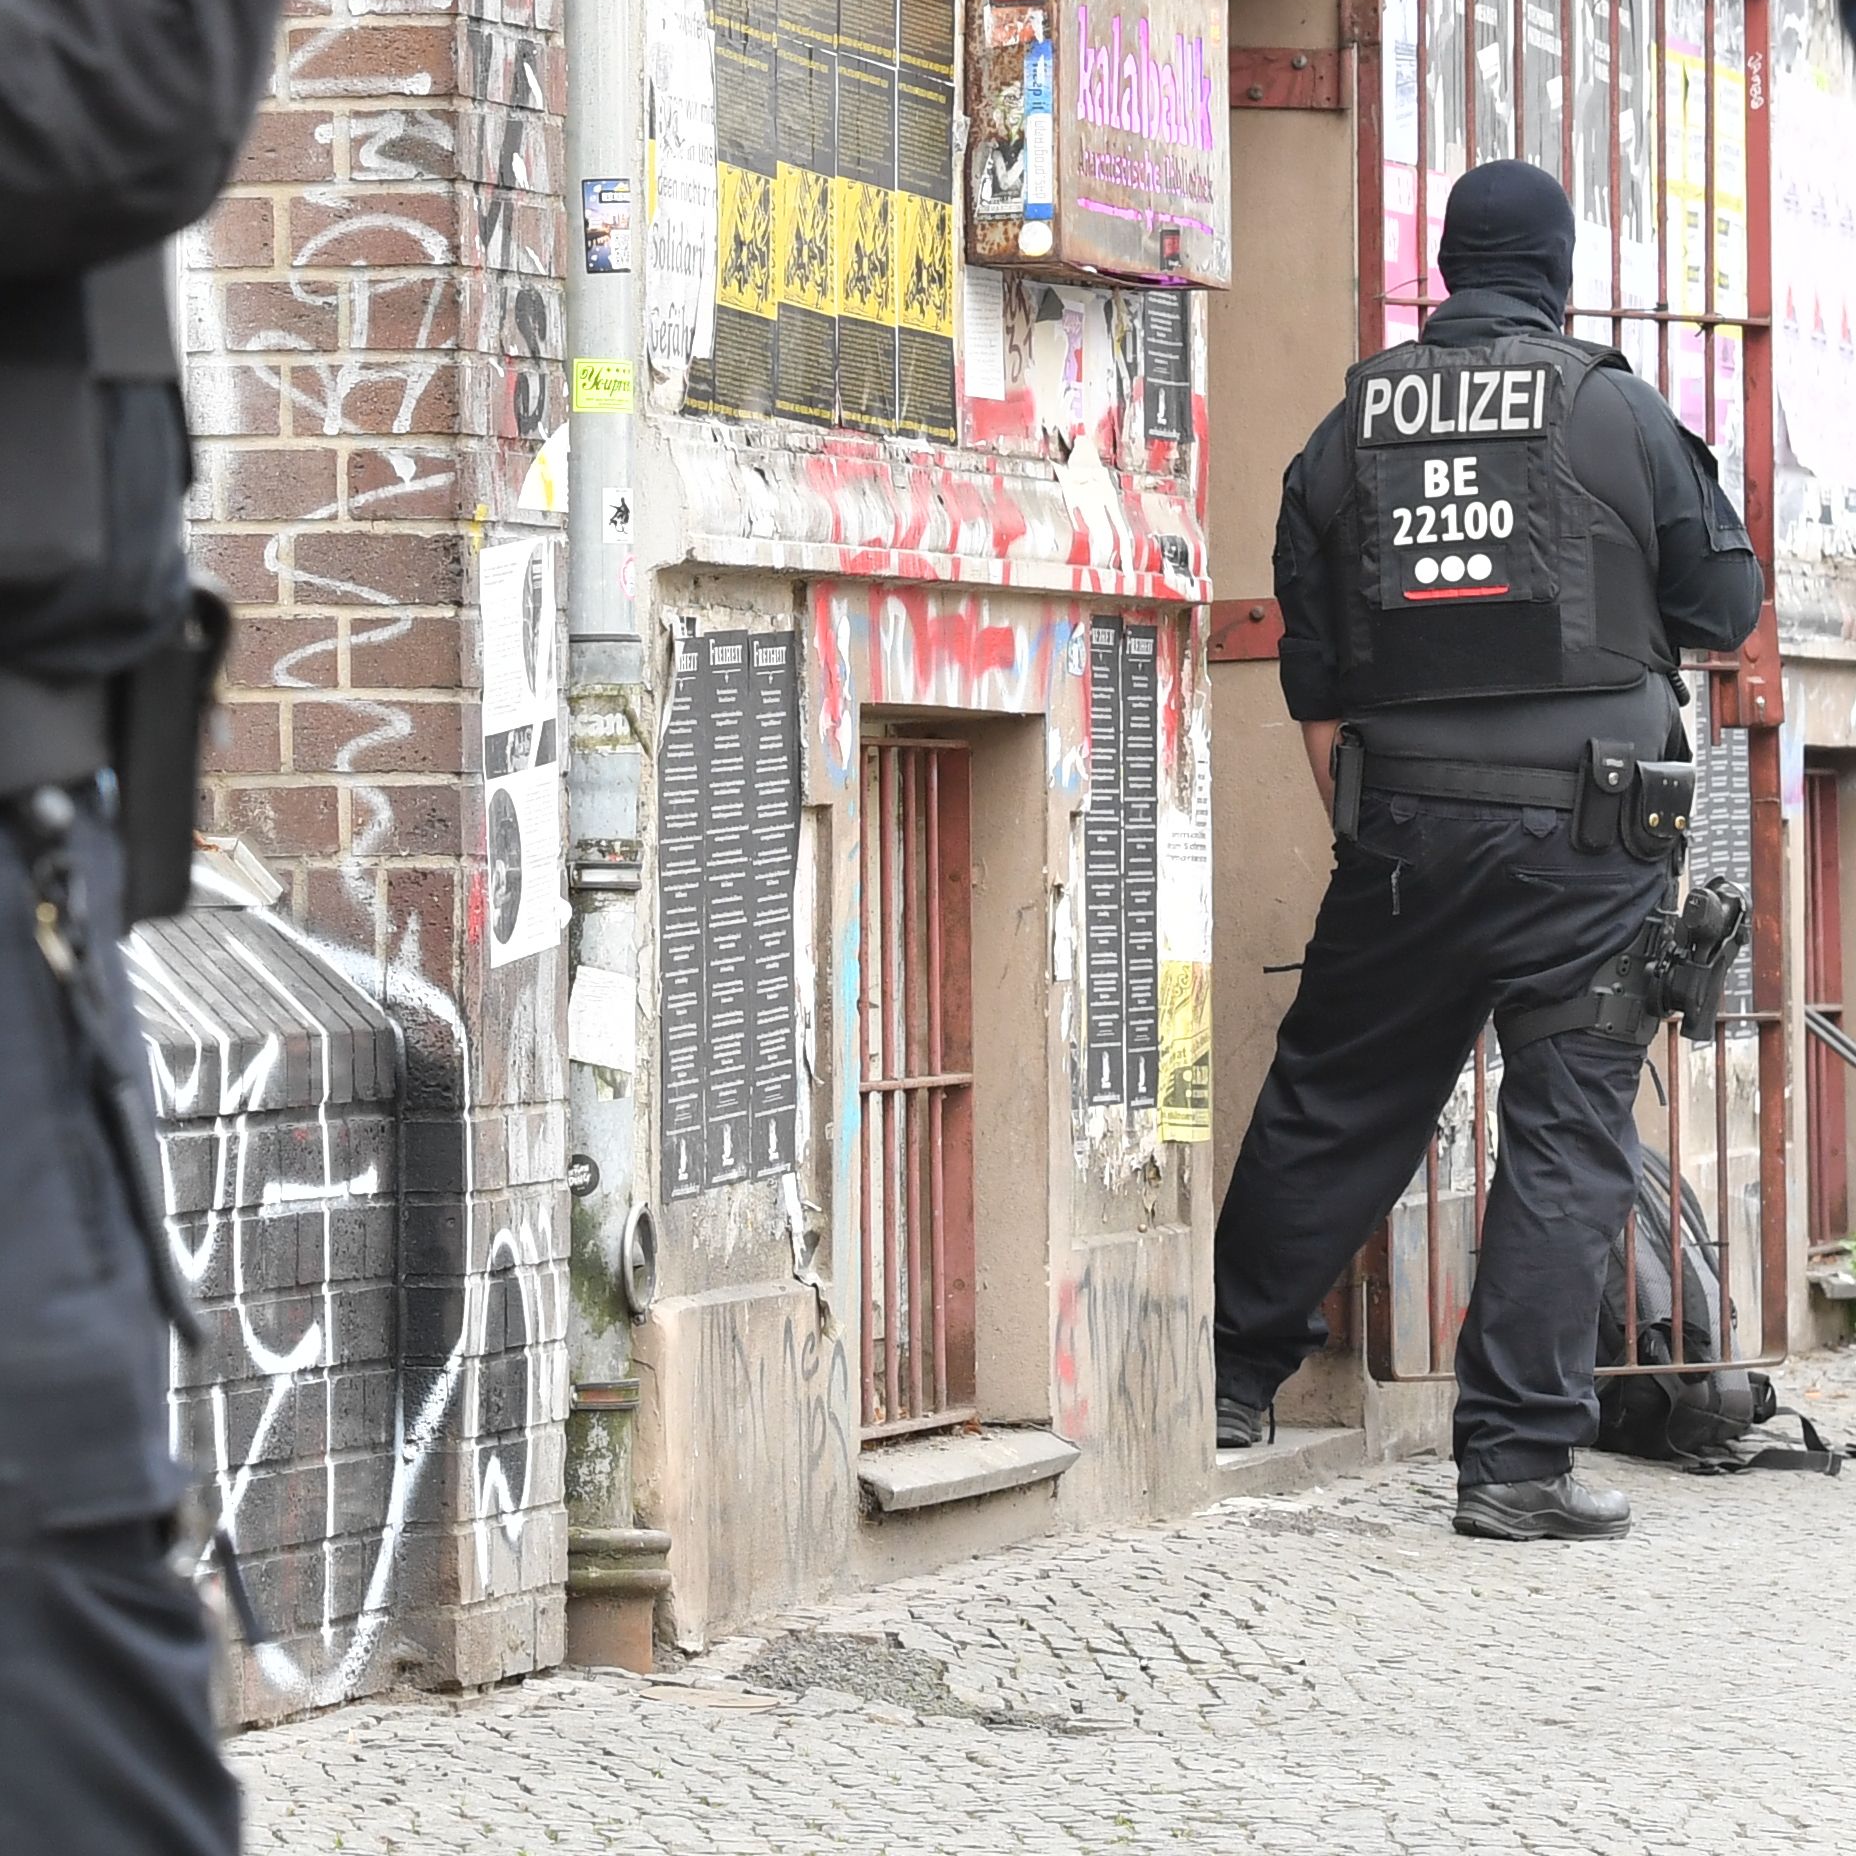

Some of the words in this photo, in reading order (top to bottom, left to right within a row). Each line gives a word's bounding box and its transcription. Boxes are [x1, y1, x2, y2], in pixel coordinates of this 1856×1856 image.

[1363, 369, 1546, 439] POLIZEI
[1424, 456, 1478, 498] BE
[1392, 500, 1514, 546] 22100
[709, 638, 743, 667] FREIHEIT
[753, 640, 787, 668] FREIHEIT
